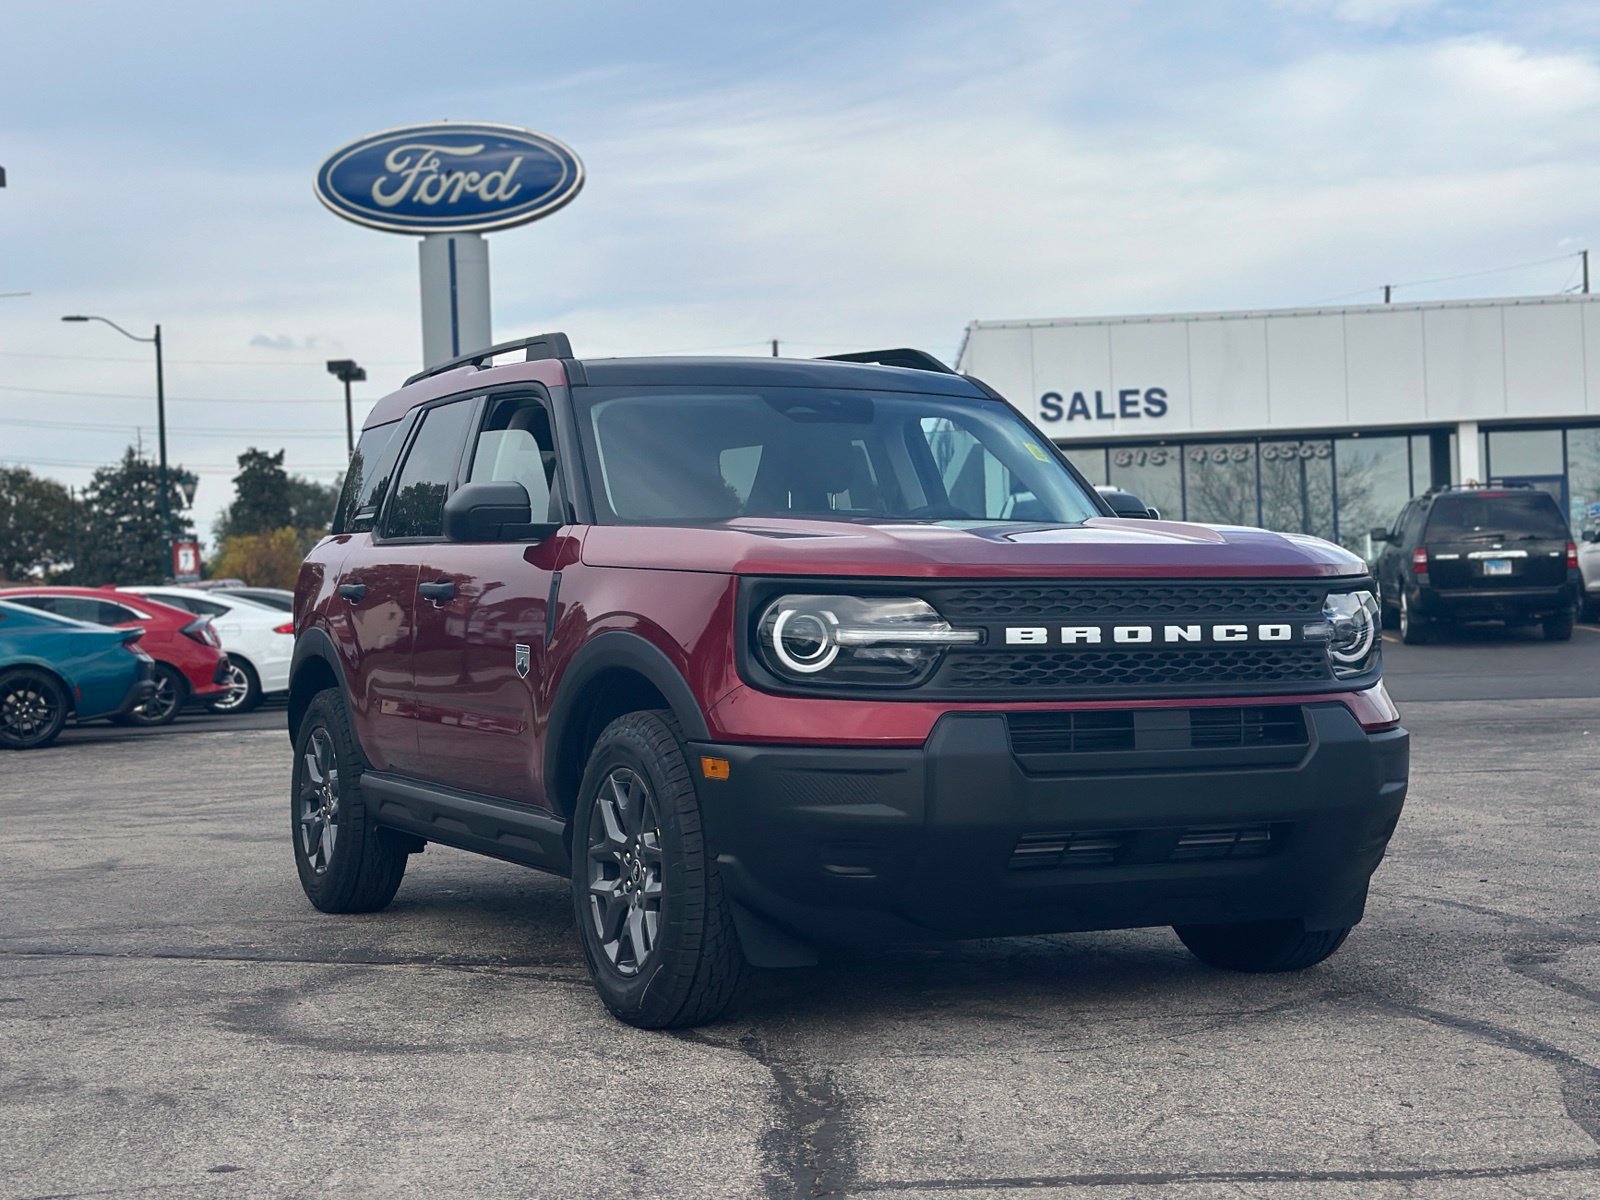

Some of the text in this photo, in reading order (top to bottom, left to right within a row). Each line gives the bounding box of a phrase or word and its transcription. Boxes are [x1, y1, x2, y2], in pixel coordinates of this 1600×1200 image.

[371, 144, 523, 207] Ford
[1040, 387, 1168, 422] SALES
[1005, 624, 1292, 645] BRONCO
